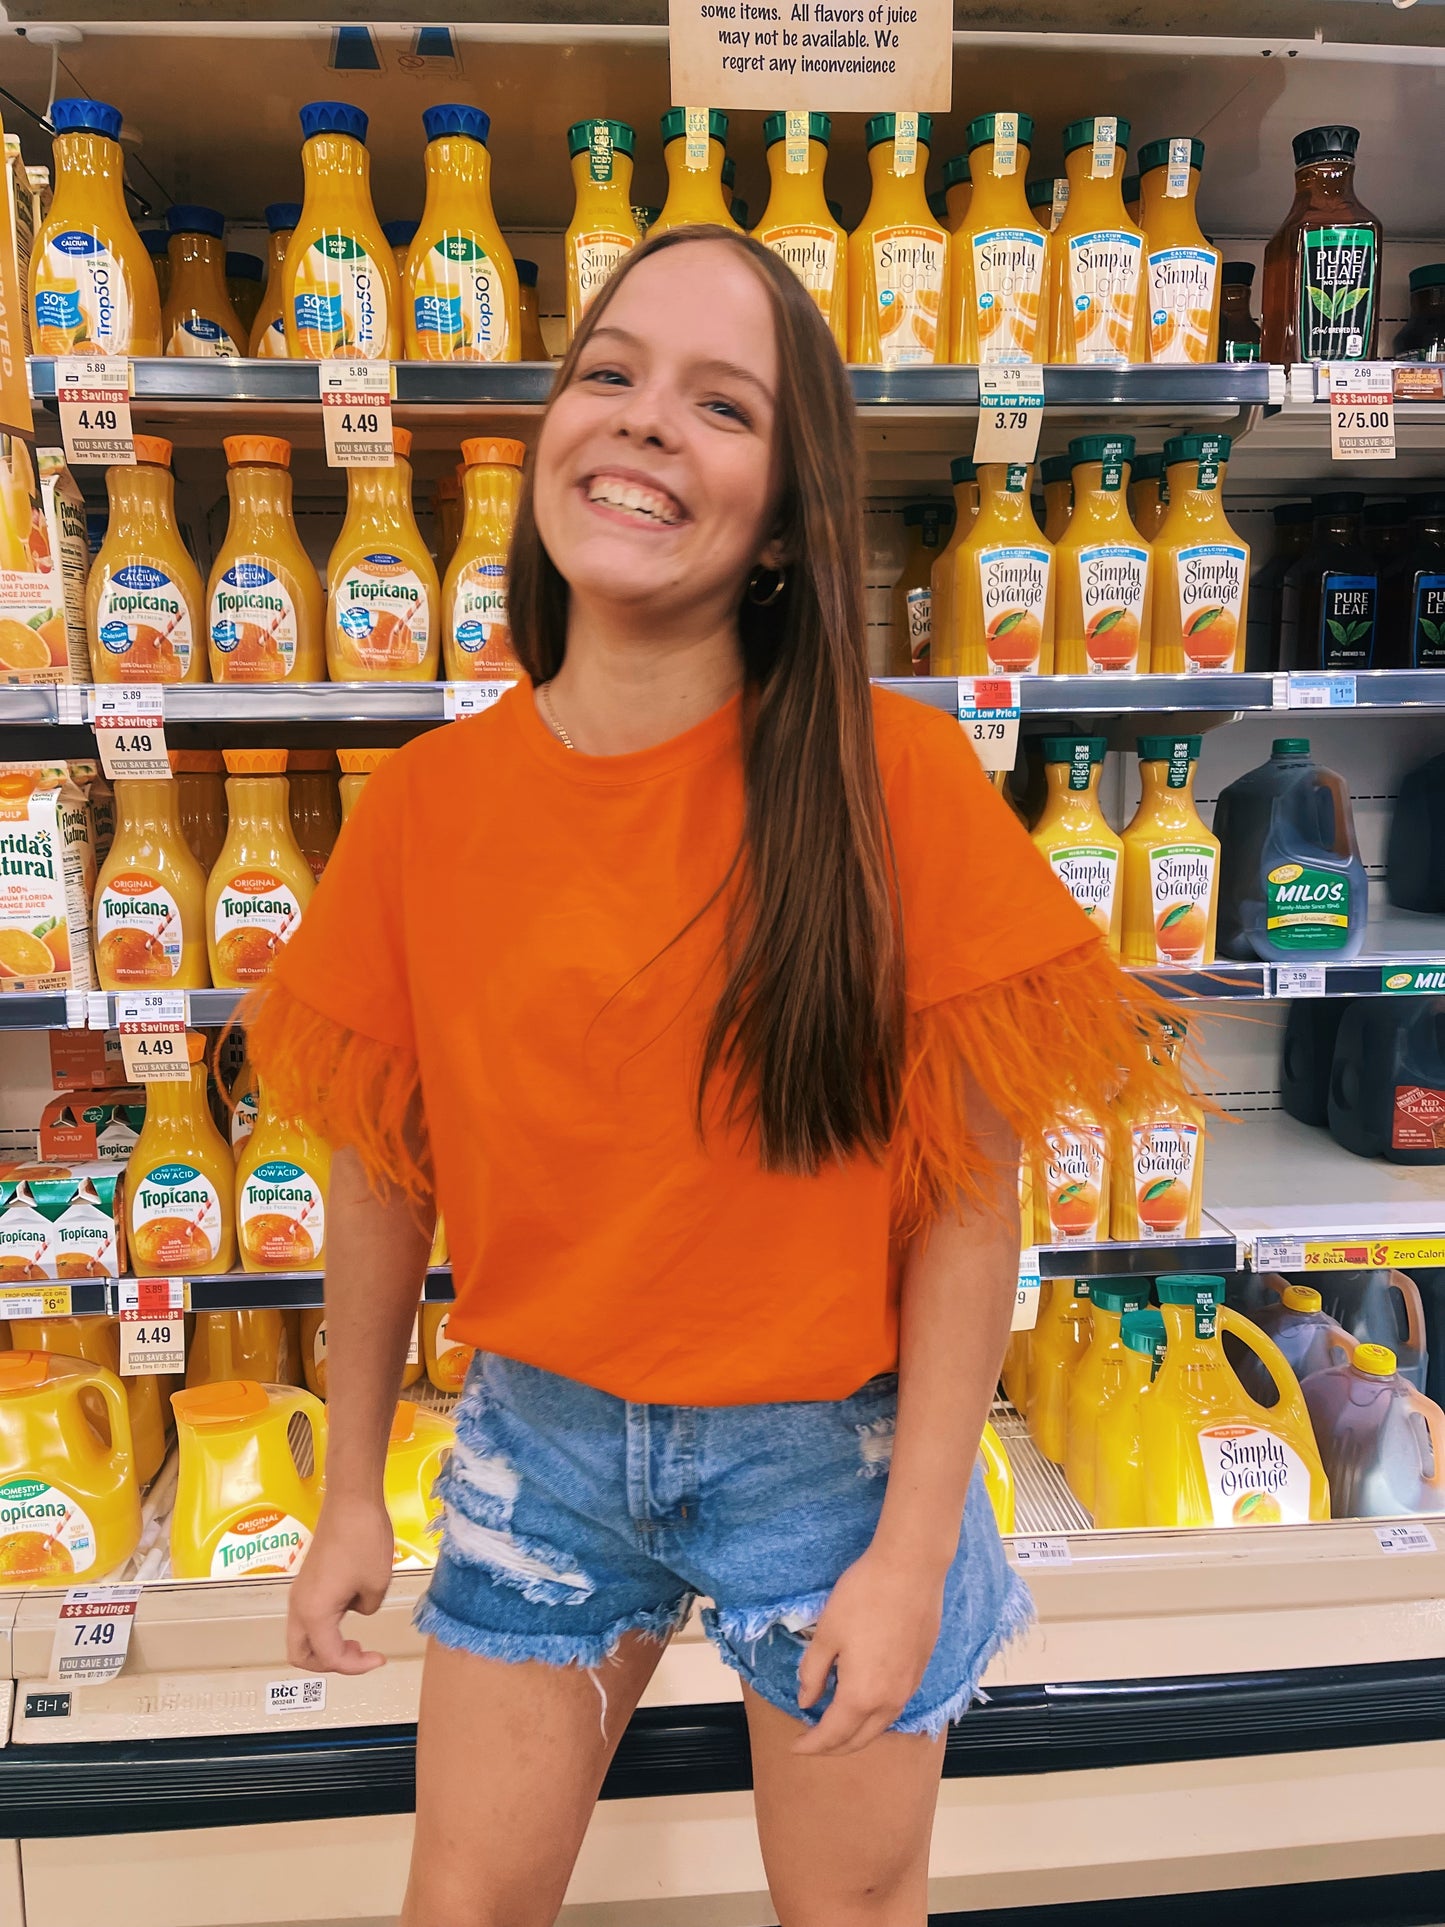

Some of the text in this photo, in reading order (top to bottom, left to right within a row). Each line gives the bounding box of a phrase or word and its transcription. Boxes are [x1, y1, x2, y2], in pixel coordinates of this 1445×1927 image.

[701, 3, 917, 25] some items. All flavors of juice
[719, 29, 899, 48] may not be available. We
[722, 54, 896, 75] regret any inconvenience
[880, 241, 936, 271] Simply
[980, 243, 1037, 272] Simply
[1076, 246, 1134, 274] Simply
[1316, 250, 1362, 265] PURE
[1154, 264, 1208, 292] Simply
[43, 293, 68, 306] 50%
[304, 296, 330, 309] 50%
[424, 298, 450, 310] 50%
[87, 364, 106, 372] 5.89
[350, 368, 368, 376] 5.89
[1004, 370, 1020, 379] 3.79
[1355, 369, 1371, 377] 2.69
[64, 390, 123, 402] $$ Savings
[328, 394, 386, 406] $$ Savings
[982, 396, 1040, 406] Our Low Price
[1350, 394, 1388, 404] Savings
[78, 410, 116, 430] 4.49
[342, 414, 378, 433] 4.49
[995, 412, 1027, 430] 3.79
[1338, 412, 1388, 428] 2/5.00
[75, 440, 112, 450] YOU SAVE
[336, 444, 373, 452] YOU SAVE
[120, 572, 160, 583] CALCIUM
[228, 570, 266, 580] CALCIUM
[988, 560, 1043, 589] Simply
[1086, 559, 1141, 587] Simply
[1186, 558, 1238, 586] Simply
[347, 579, 418, 600] Tropicana
[986, 583, 1041, 607] Orange
[1086, 582, 1140, 606] Orange
[1183, 580, 1238, 604] Orange
[106, 591, 179, 614] Tropicana
[216, 590, 283, 614] Tropicana
[1335, 592, 1368, 603] PURE
[1334, 604, 1368, 614] LEAF
[480, 688, 498, 698] 5.89
[982, 682, 998, 691] 3.79
[123, 691, 142, 700] 5.89
[961, 709, 1016, 719] Our Low Price
[100, 716, 158, 728] $$ Savings
[974, 724, 1005, 740] 3.79
[115, 736, 152, 752] 4.49
[1059, 860, 1110, 884] Simply
[1157, 859, 1208, 882] Simply
[235, 879, 275, 887] ORIGINAL
[1156, 880, 1207, 901] Orange
[103, 898, 168, 919] Tropicana
[222, 896, 291, 918] Tropicana
[145, 997, 163, 1006] 5.89
[124, 1022, 180, 1032] $$ Savings
[138, 1040, 173, 1055] 4.49
[98, 1144, 134, 1156] Tropican
[1138, 1134, 1191, 1160] Simply
[1138, 1154, 1190, 1174] Orange
[172, 1170, 193, 1178] ACID
[257, 1169, 275, 1177] LOW
[140, 1188, 208, 1208] Tropicana
[246, 1186, 312, 1204] Tropicana
[58, 1227, 108, 1241] Tropicana
[1394, 1249, 1445, 1258] Zero Calori
[145, 1285, 162, 1294] 5.89
[136, 1327, 170, 1344] 4.49
[130, 1354, 144, 1362] YOU
[1220, 1438, 1287, 1470] Simply
[1222, 1468, 1288, 1497] Orange
[1, 1502, 66, 1522] opicana
[237, 1514, 278, 1530] ORIGINAL
[220, 1532, 300, 1566] Tropicana
[1032, 1541, 1048, 1549] 7.79
[66, 1603, 130, 1616] $$ Savings
[74, 1623, 114, 1646] 7.49
[62, 1657, 100, 1668] YOU SAVE
[270, 1686, 298, 1698] BGC
